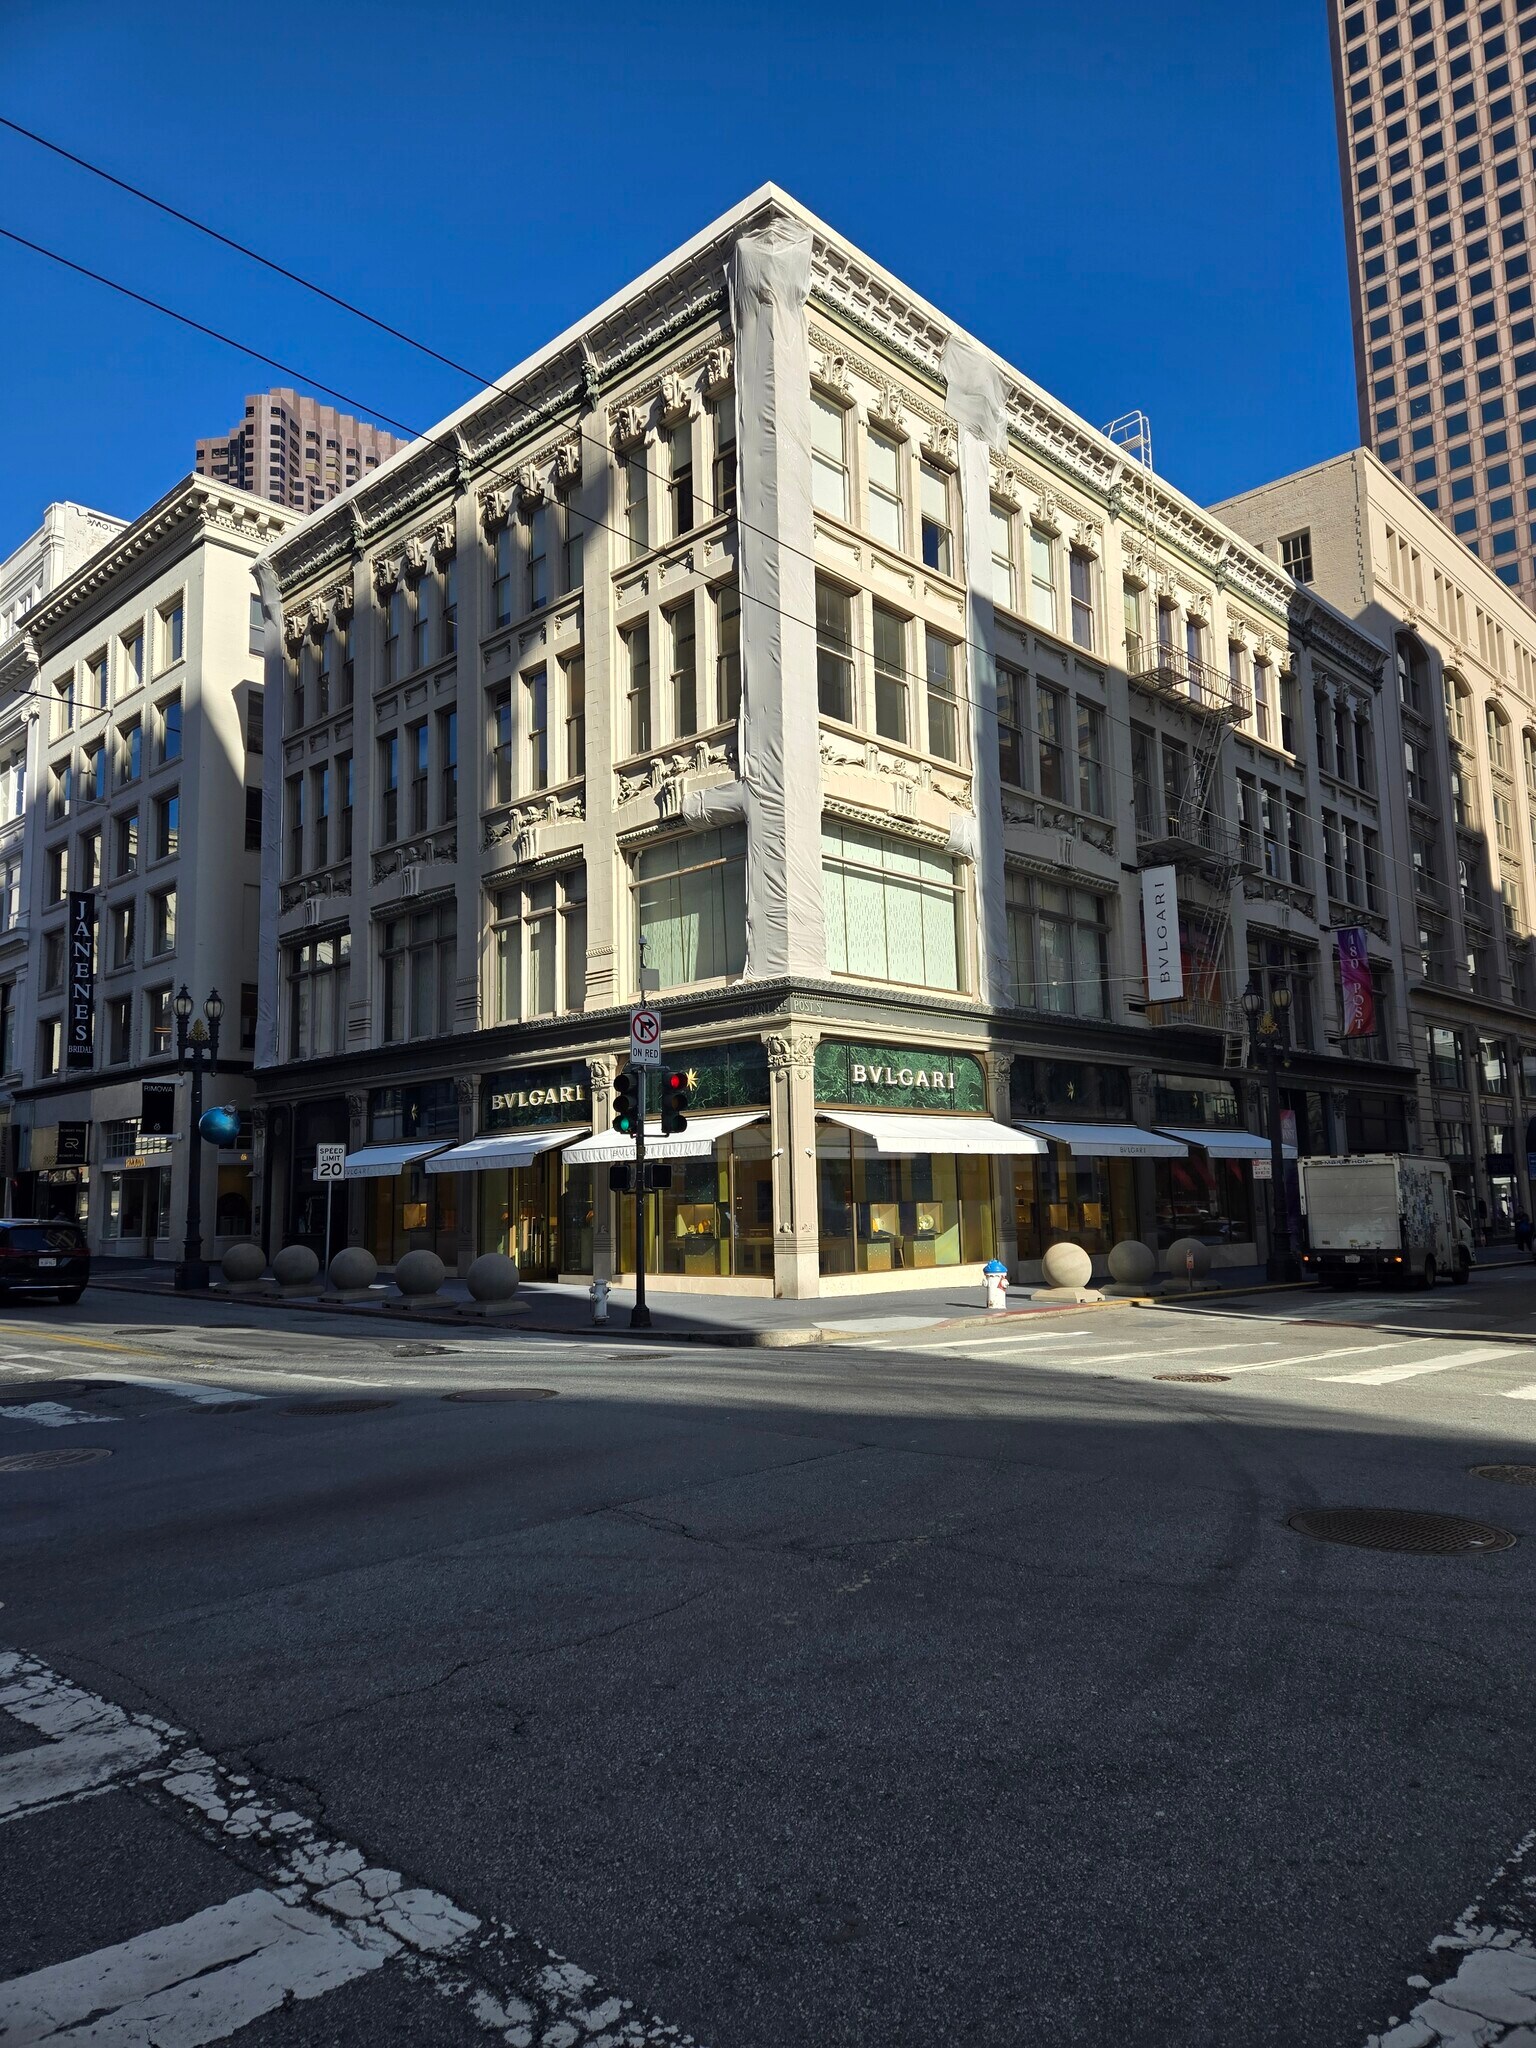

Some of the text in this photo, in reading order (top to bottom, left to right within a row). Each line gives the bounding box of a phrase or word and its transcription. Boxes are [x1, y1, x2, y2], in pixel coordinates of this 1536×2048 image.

[1155, 882, 1171, 984] BVLGARI
[73, 900, 92, 1041] JANENES
[1349, 934, 1365, 1030] 180 POST
[742, 1001, 772, 1017] GRANT
[794, 999, 814, 1012] POST
[68, 1045, 93, 1054] BRIDAL
[633, 1047, 659, 1059] ON RED
[851, 1064, 956, 1089] BVLGARI
[143, 1085, 174, 1093] RIMOWA
[492, 1084, 587, 1111] BVLGARI
[319, 1147, 344, 1155] SPEED
[1119, 1146, 1146, 1154] BVLGARI
[320, 1162, 342, 1176] 20
